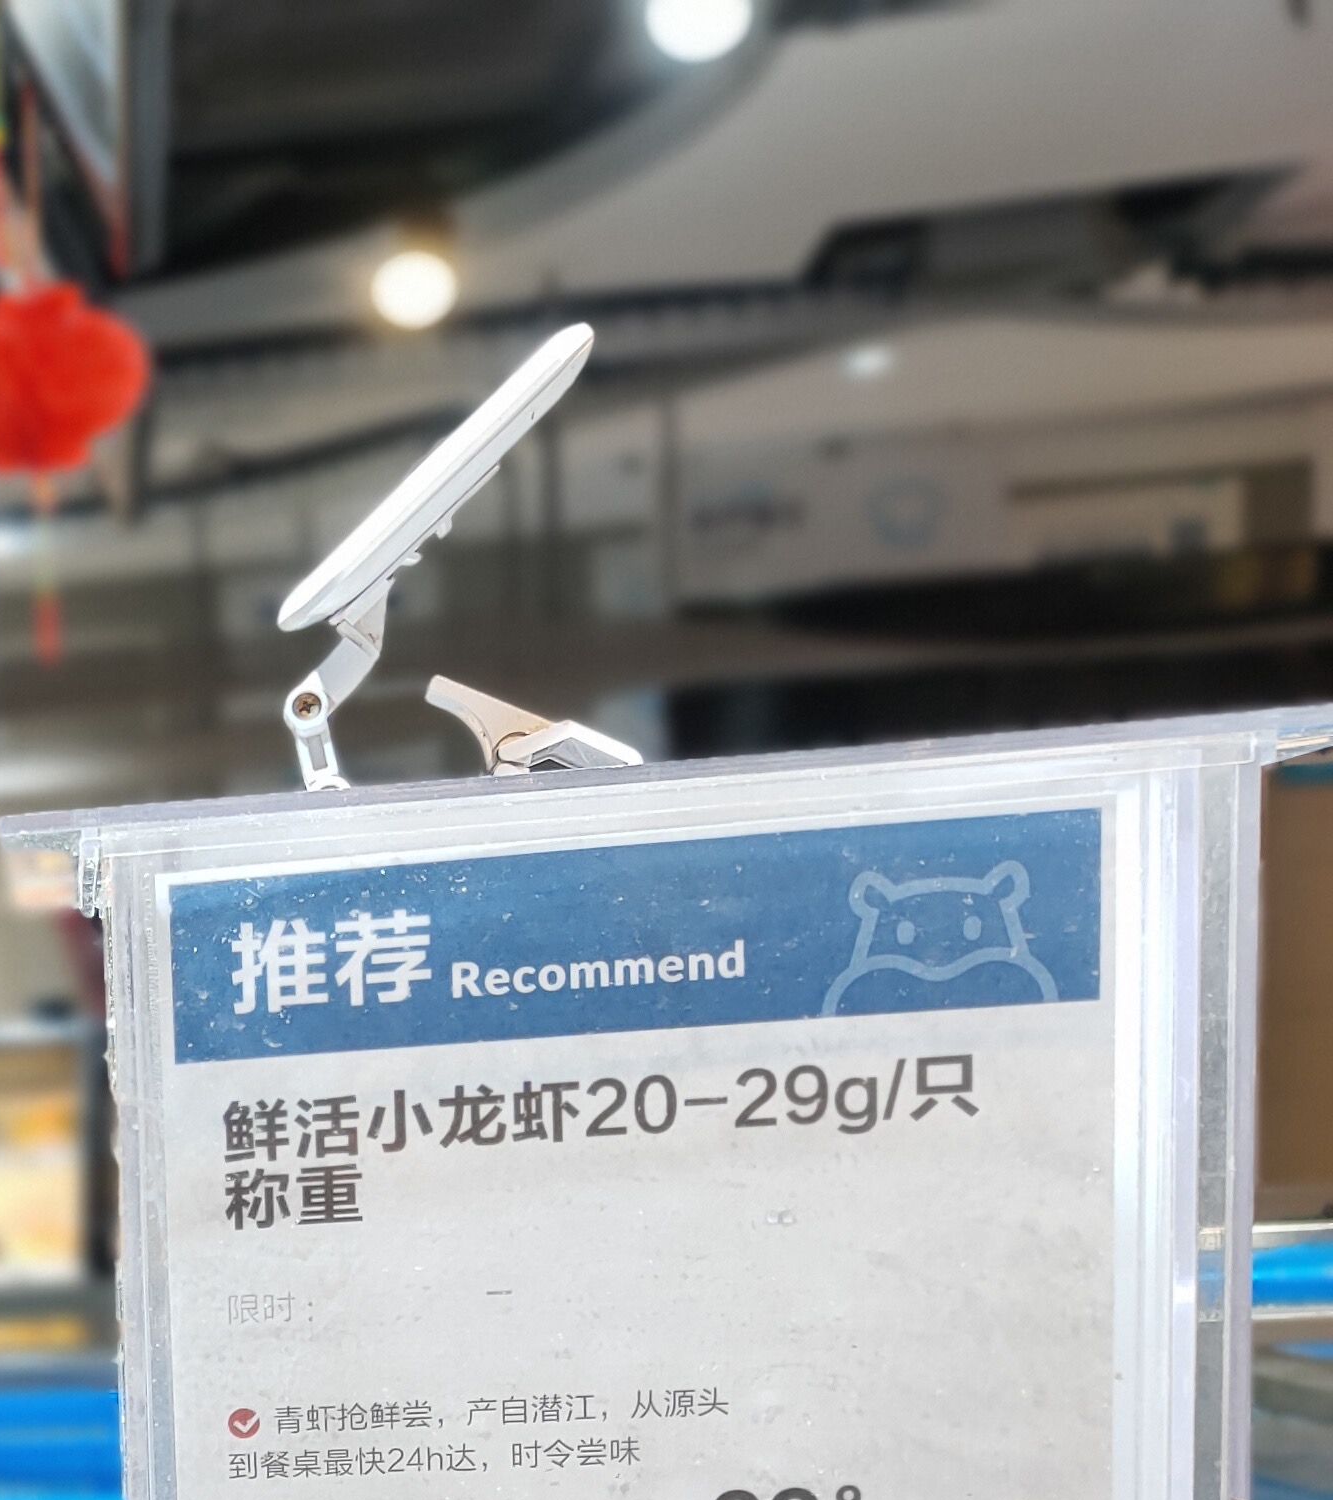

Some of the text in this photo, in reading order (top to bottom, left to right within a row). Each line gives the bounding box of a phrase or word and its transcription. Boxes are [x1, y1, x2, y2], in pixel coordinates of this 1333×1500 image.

[232, 909, 746, 1015] 推荐 Recommend
[224, 1163, 364, 1231] 称重
